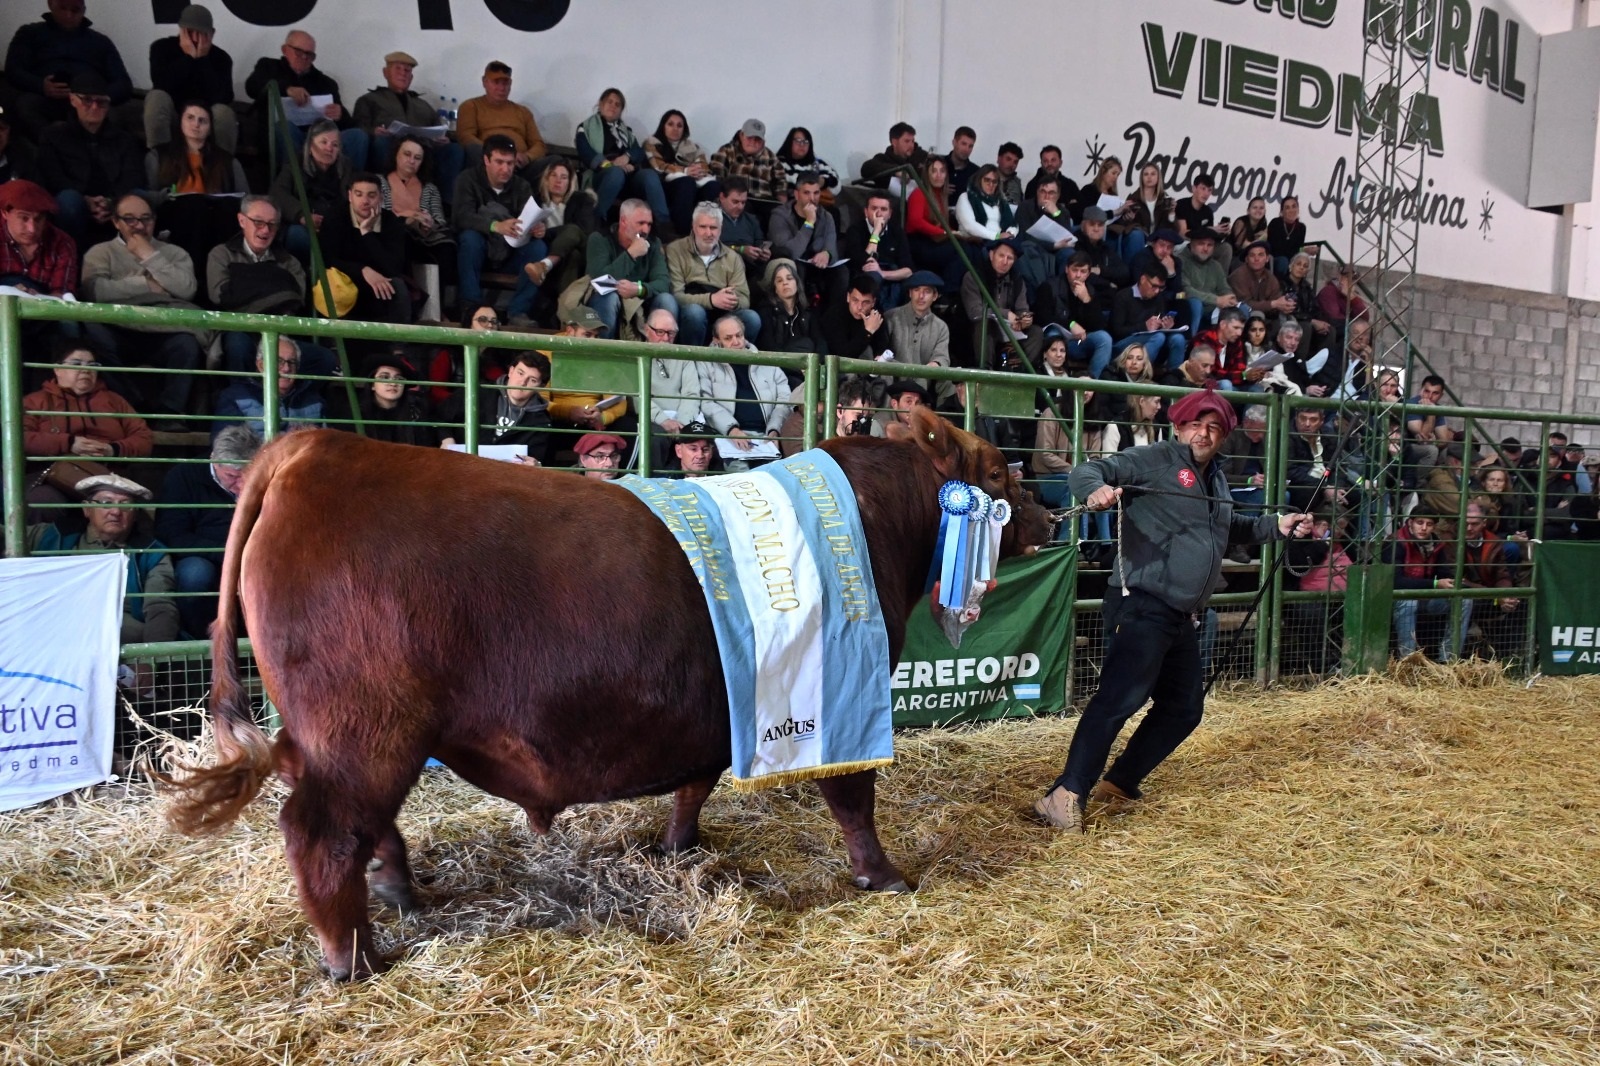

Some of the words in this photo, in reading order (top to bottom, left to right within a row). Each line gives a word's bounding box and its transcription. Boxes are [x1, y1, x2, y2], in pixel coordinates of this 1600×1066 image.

[1141, 21, 1444, 157] VIEDMA
[1123, 121, 1298, 213] Patagonia
[1308, 156, 1468, 234] Argentina
[826, 534, 855, 556] DE
[752, 531, 800, 612] MACHO
[836, 563, 869, 622] ANGUS
[890, 652, 1040, 689] EREFORD
[0, 698, 77, 733] tiva
[893, 686, 1008, 712] ARGENTINA
[762, 717, 815, 742] ANGUS
